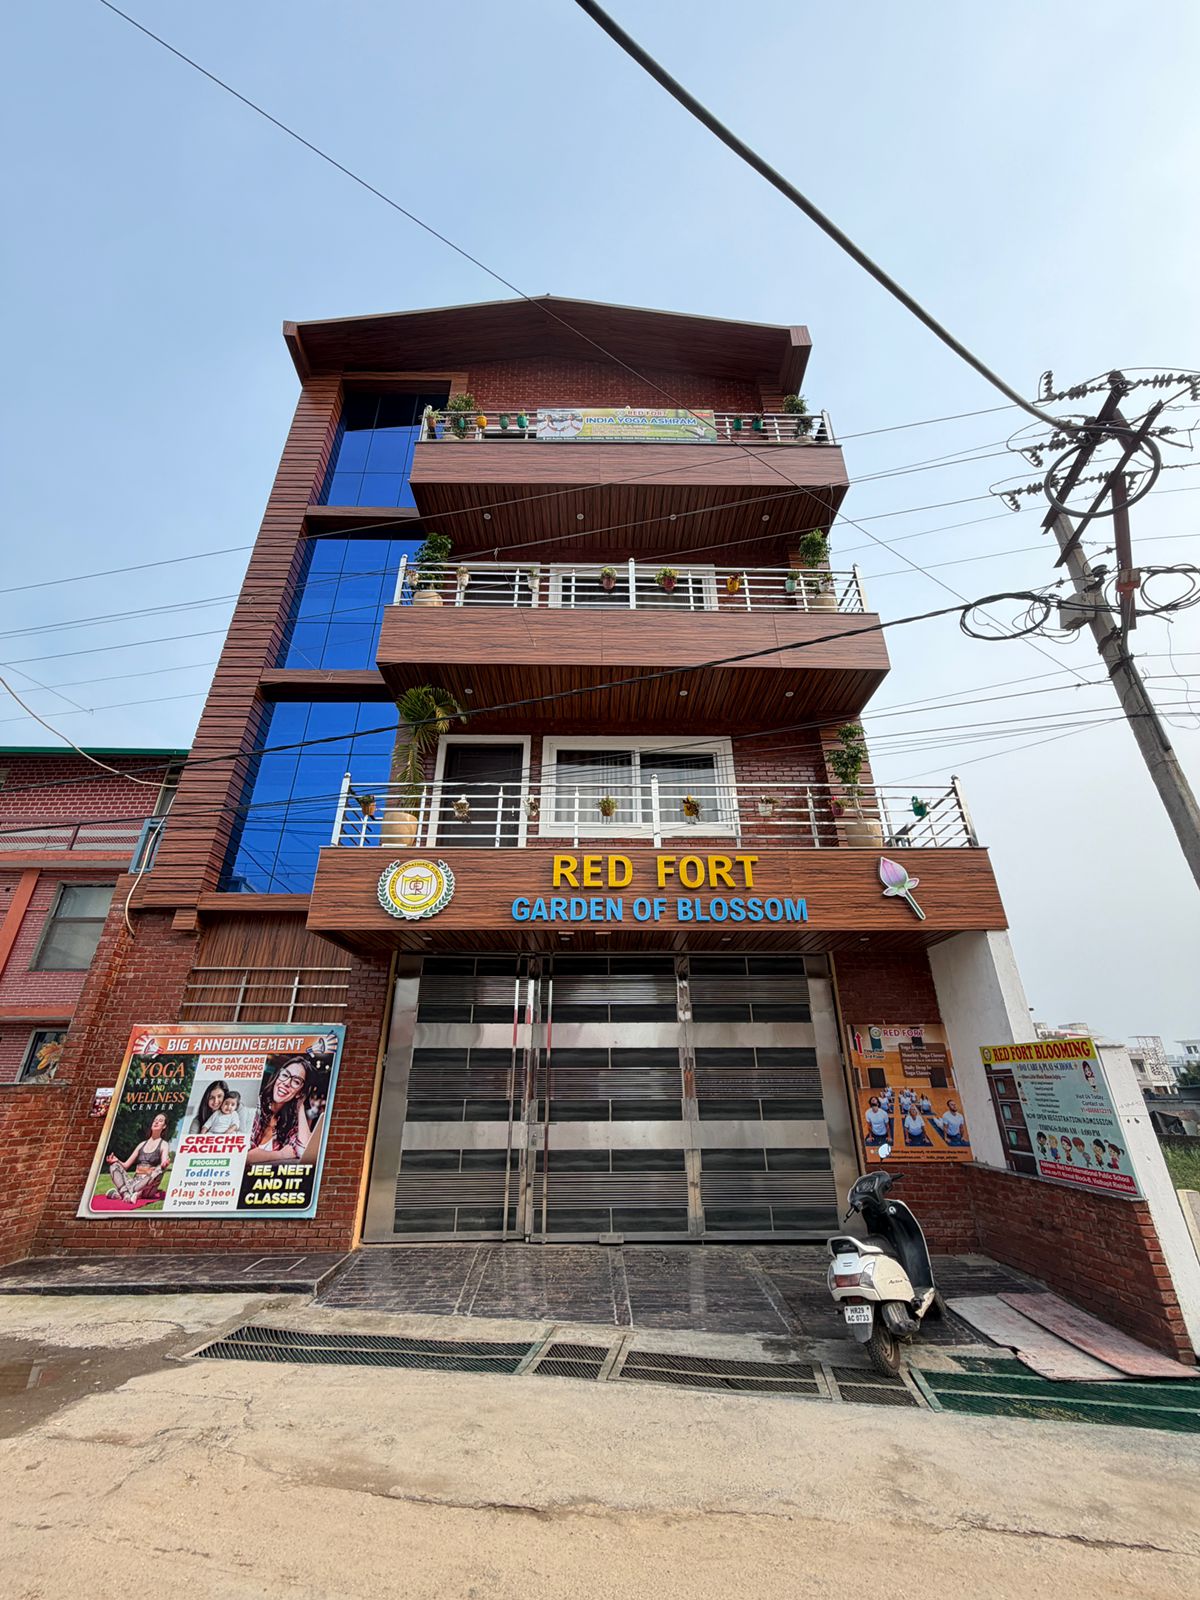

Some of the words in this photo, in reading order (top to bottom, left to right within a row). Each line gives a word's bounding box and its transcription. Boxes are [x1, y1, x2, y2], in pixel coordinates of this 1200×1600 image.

[552, 854, 634, 888] RED
[656, 855, 759, 888] FORT
[512, 897, 623, 922] GARDEN
[632, 898, 667, 922] OF
[676, 898, 809, 922] BLOSSOM
[166, 1038, 190, 1051] BIG
[193, 1038, 304, 1051] ANNOUNCEMENT
[993, 1047, 1010, 1062] RED
[1010, 1045, 1034, 1060] FORT
[1036, 1042, 1090, 1059] BLOOMING
[140, 1062, 185, 1078] YOGA
[127, 1092, 186, 1103] WELLNESS
[185, 1136, 245, 1144] CRECHE
[179, 1145, 246, 1153] FACILITY
[185, 1169, 231, 1177] Toddlers
[247, 1164, 275, 1177] JEE,
[277, 1164, 313, 1176] NEET
[252, 1178, 283, 1190] AND
[285, 1178, 303, 1190] IIT
[171, 1188, 195, 1199] Play
[199, 1188, 236, 1197] School
[245, 1192, 306, 1204] CLASSES
